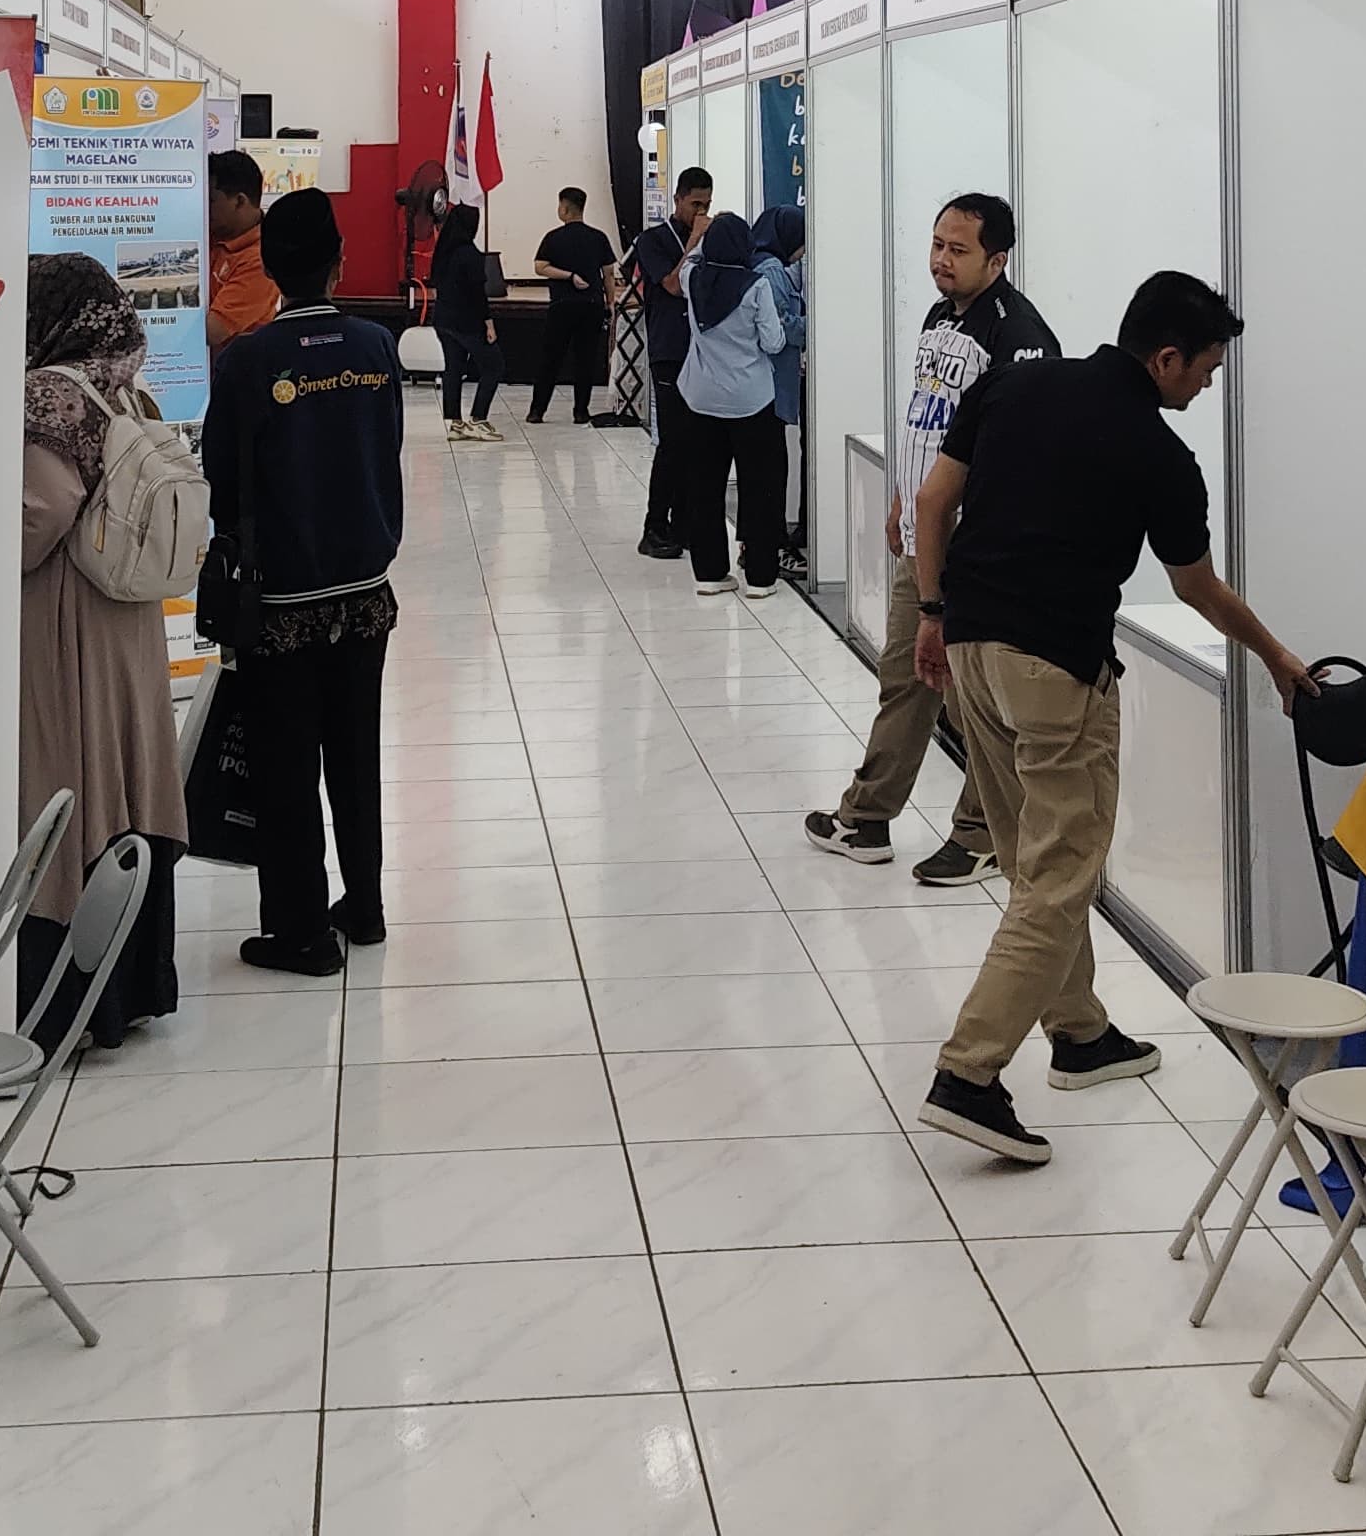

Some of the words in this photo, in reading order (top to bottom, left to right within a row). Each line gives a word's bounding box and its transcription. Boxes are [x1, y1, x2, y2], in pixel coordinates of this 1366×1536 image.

[63, 137, 108, 149] TEKNIK
[112, 138, 148, 149] TIRTA
[152, 138, 195, 150] WIYATA
[66, 154, 138, 165] MAGELANG
[54, 175, 81, 185] STUDI
[106, 174, 139, 184] TEKNIK
[141, 174, 193, 184] LINGKUNGAN
[46, 197, 92, 208] BIDANG
[95, 196, 159, 207] KEAHLIAN
[50, 215, 81, 225] SUMBER
[83, 215, 95, 224] AIR
[97, 214, 112, 224] DAN
[115, 214, 156, 224] BANGUNAN
[111, 226, 124, 235] AIR
[126, 226, 154, 235] MINUM
[150, 315, 177, 325] MINUM
[298, 374, 339, 396] Sweet
[340, 369, 390, 391] Orange
